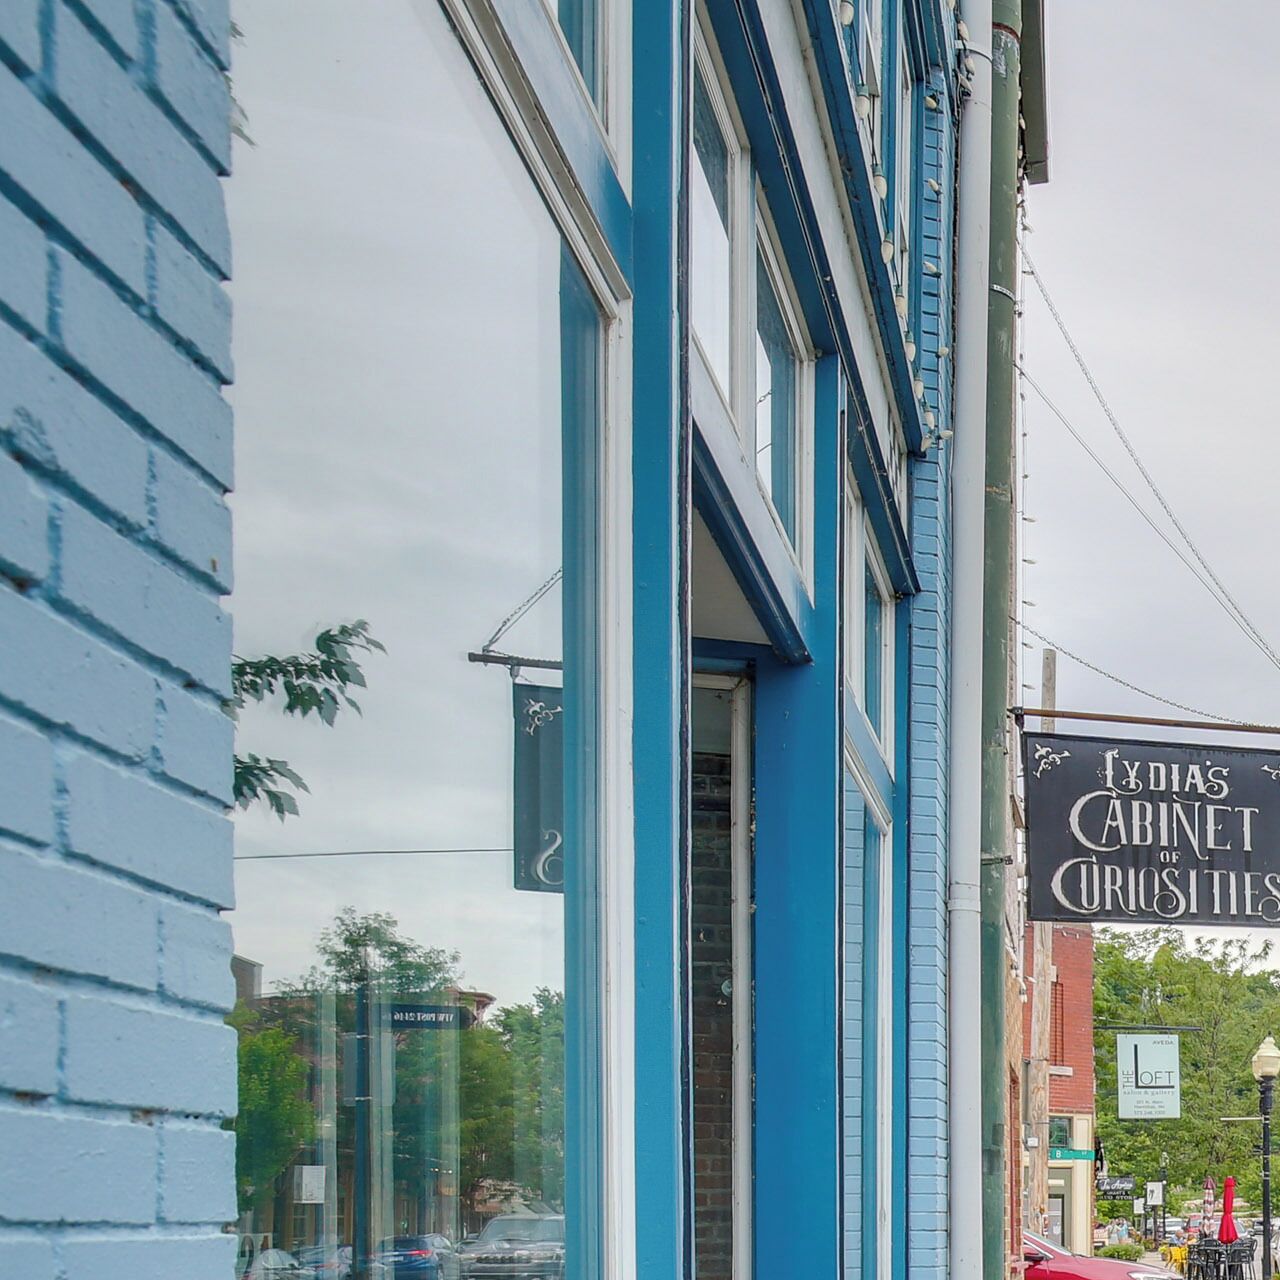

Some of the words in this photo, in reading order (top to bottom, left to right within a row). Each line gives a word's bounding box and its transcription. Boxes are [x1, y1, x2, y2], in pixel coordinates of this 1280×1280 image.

[1097, 749, 1229, 799] LYDIA'S
[1069, 791, 1259, 860] CABINET
[1122, 1070, 1134, 1088] THE
[1134, 1043, 1175, 1089] LOFT
